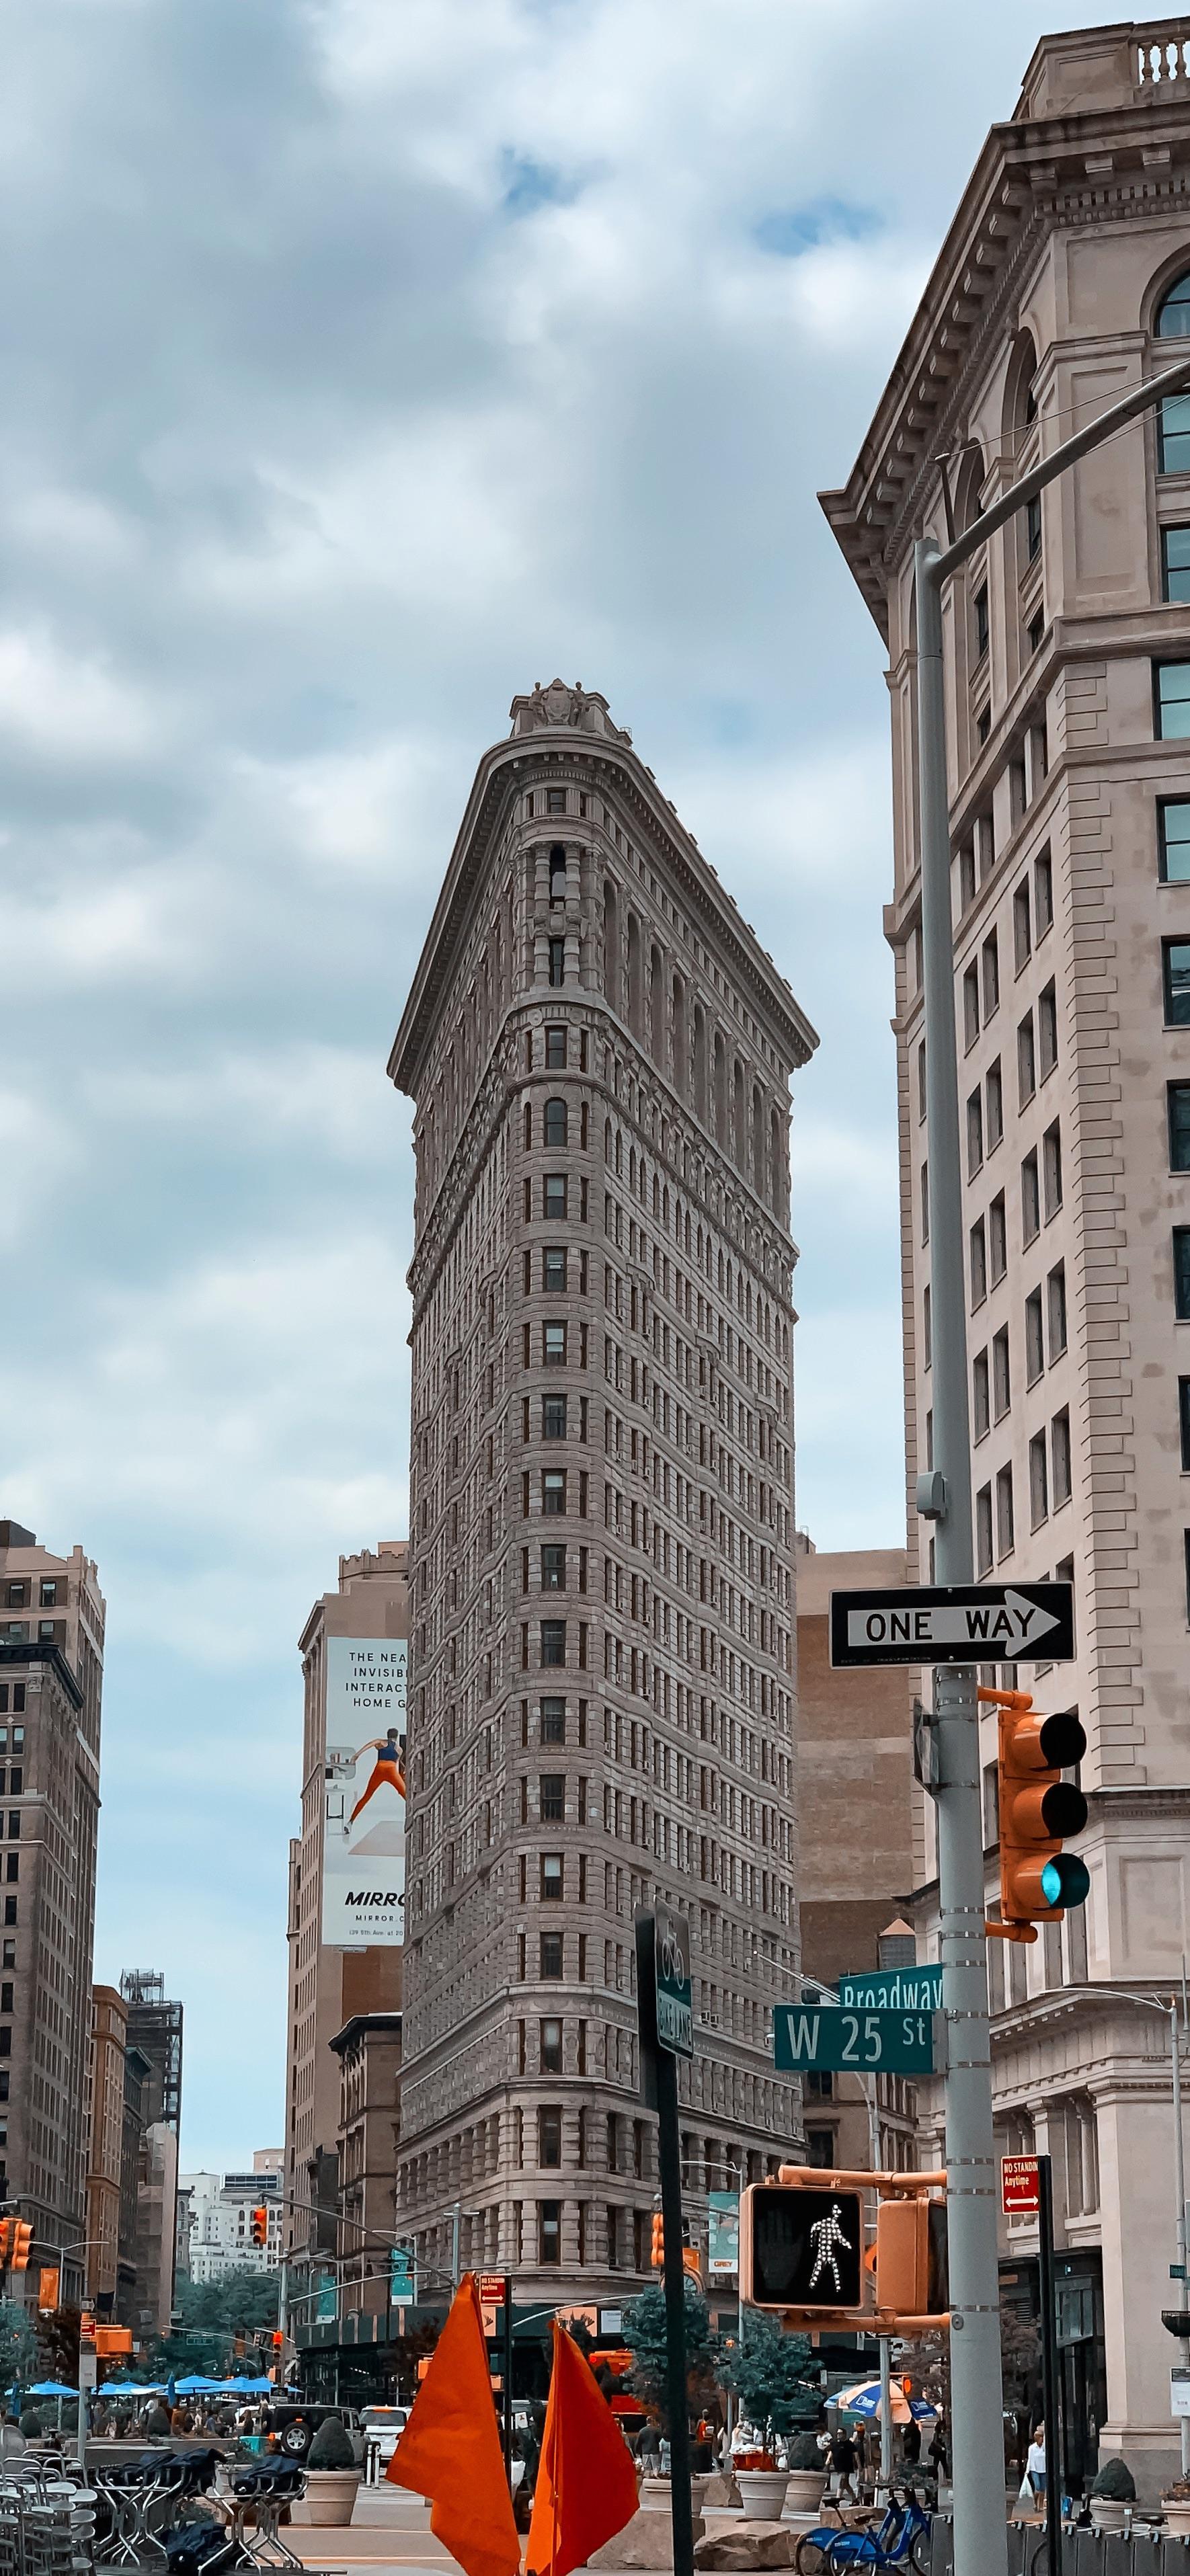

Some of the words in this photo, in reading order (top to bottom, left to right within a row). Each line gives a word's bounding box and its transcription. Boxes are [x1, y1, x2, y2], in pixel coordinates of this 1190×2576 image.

[866, 1611, 933, 1642] ONE
[965, 1609, 1036, 1639] WAY
[349, 1652, 374, 1662] THE
[381, 1653, 406, 1663] NEA
[354, 1668, 407, 1678] INVISIB
[354, 1697, 391, 1708] HOME
[844, 1975, 943, 2009] Broadway
[787, 2014, 820, 2060] W
[841, 2015, 882, 2062] 25
[902, 2017, 926, 2046] St
[1004, 2163, 1013, 2174] NO
[1004, 2175, 1030, 2188] Anytime
